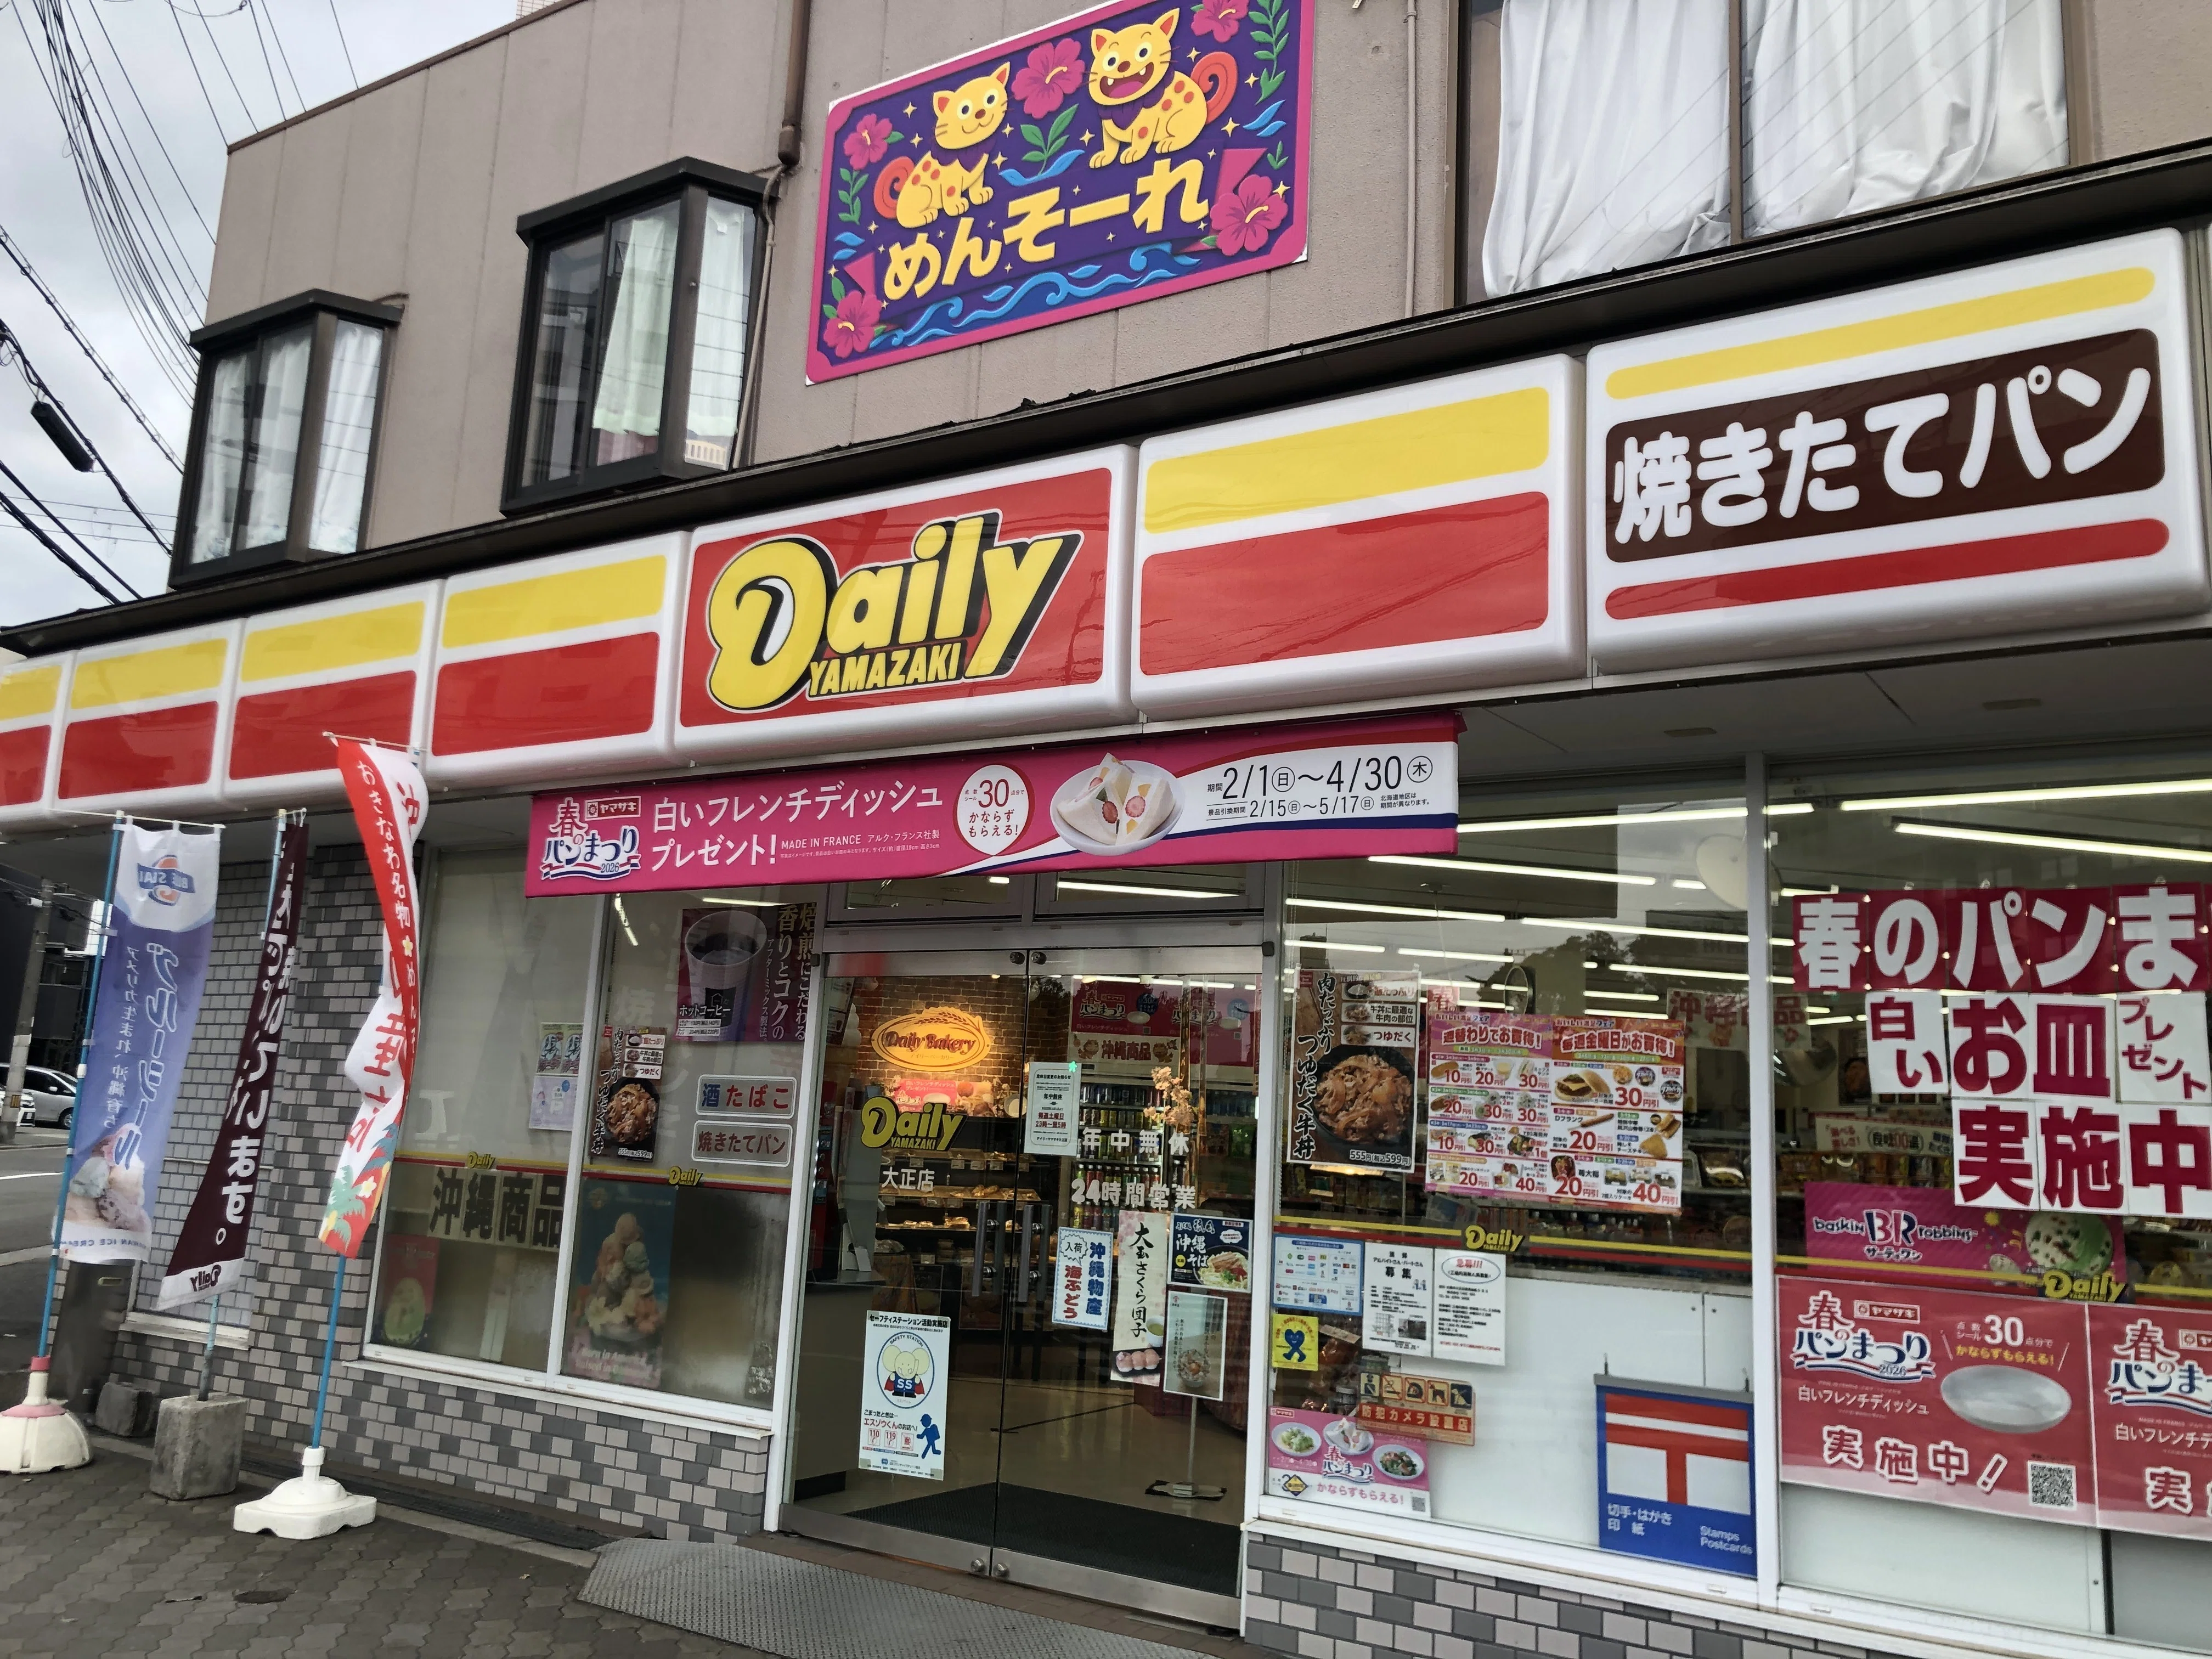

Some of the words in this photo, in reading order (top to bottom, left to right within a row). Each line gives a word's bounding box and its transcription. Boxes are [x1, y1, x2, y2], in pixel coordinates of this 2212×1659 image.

[884, 159, 1209, 300] めんそーれ
[1614, 365, 2151, 545] 焼きたてパン
[708, 510, 1082, 712] Daily
[809, 642, 961, 697] YAMAZAKI
[978, 778, 1009, 808] 30
[1207, 783, 1223, 793] 期間
[1380, 792, 1417, 802] 北海道地区は
[600, 801, 637, 814] ヤマザキ
[653, 780, 944, 833] 白いフレンチディッシュ
[969, 809, 1015, 823] かならず
[1207, 806, 1246, 816] 景品引換期間
[1380, 799, 1430, 809] 期間が異なります。
[357, 760, 412, 929] おきなわ名物
[651, 833, 777, 872] プレゼント!
[781, 839, 808, 850] MADE
[810, 838, 820, 848] IN
[823, 834, 861, 847] FRANCE
[601, 862, 620, 873] 2026
[1798, 886, 2211, 990] 春のパンま
[771, 906, 799, 1040] 香りとコクの
[795, 902, 816, 1041] 焙煎にこだわる
[679, 1005, 731, 1017] ホットコーヒー
[1317, 972, 1337, 1055] 肉たっぷり
[1370, 1005, 1414, 1014] 牛丼に最適な
[1375, 1014, 1413, 1024] 牛肉の部位
[885, 1031, 926, 1052] Daily
[925, 1034, 977, 1056] Bakery
[1373, 1031, 1412, 1042] つゆだく
[1953, 996, 2112, 1098] お皿
[1101, 1039, 1152, 1061] 沖縄商品
[640, 1068, 659, 1076] つゆだく
[702, 1083, 721, 1108] 酒
[726, 1084, 789, 1109] たばこ
[1294, 1035, 1319, 1160] つゆだく牛丼
[861, 1096, 968, 1152] Daily
[697, 1131, 786, 1155] 焼きたてパン
[891, 1136, 936, 1150] YAMAZAKI
[1082, 1127, 1189, 1154] 年中無休
[467, 1150, 496, 1169] Daily
[1957, 1104, 2211, 1215] 実施中
[669, 1166, 703, 1186] Daily
[881, 1166, 935, 1195] 大正店
[1070, 1178, 1197, 1209] 24時間営業
[1064, 1242, 1084, 1254] 入荷
[1176, 1233, 1206, 1254] 沖縄
[1465, 1224, 1525, 1252] Daily
[1187, 1254, 1209, 1267] そば
[1864, 1246, 1922, 1261] サーティワン
[1085, 1242, 1106, 1316] 沖縄物産
[1130, 1221, 1155, 1338] 大玉さくら団子
[2042, 1268, 2129, 1304] Daily
[1063, 1265, 1083, 1319] 海ぶどう
[889, 1334, 906, 1345] SAFETY
[906, 1334, 924, 1347] STATION
[1984, 1314, 2024, 1347] 30
[1878, 1363, 1906, 1377] 2026
[2112, 1361, 2211, 1394] パンま
[1798, 1384, 1930, 1415] 白いフレンチディッシュ
[1361, 1404, 1469, 1432] 防犯カメラ設置店
[870, 1429, 879, 1438] 110
[886, 1431, 896, 1440] 119
[1607, 1503, 1673, 1526] 切手・はがき
[1700, 1525, 1740, 1542] Stamps
[1700, 1536, 1753, 1555] Postcards
